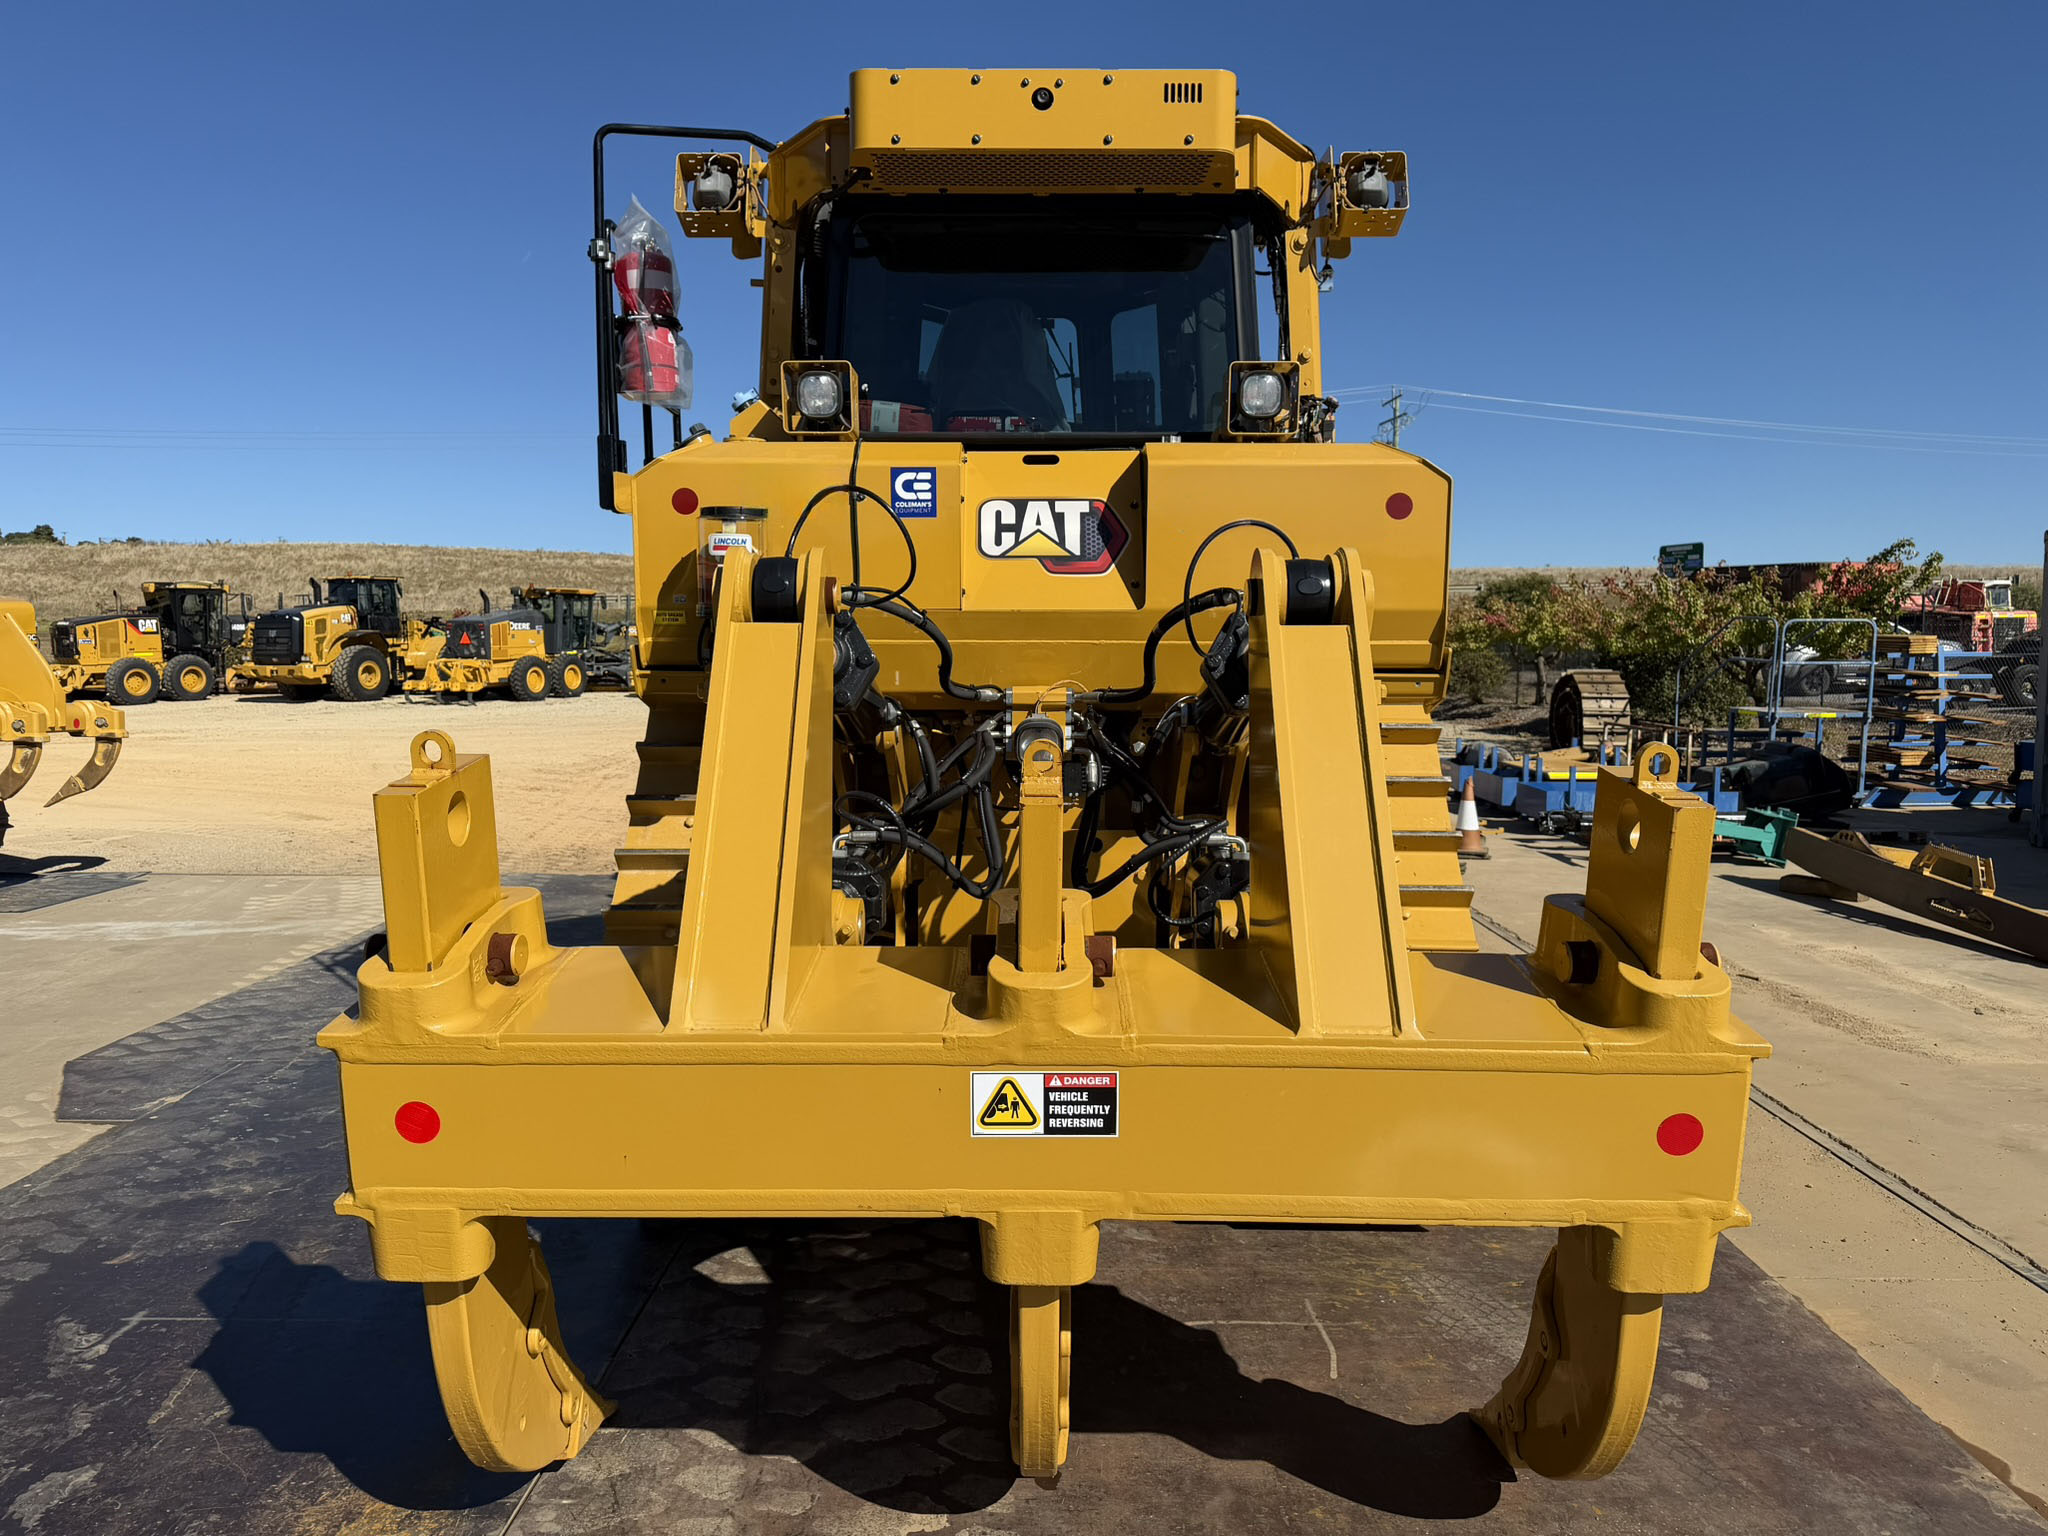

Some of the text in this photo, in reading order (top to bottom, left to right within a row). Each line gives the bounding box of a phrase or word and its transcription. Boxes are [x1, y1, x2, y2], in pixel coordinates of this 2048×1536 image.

[980, 499, 1090, 557] CAT
[713, 537, 748, 545] LINCOLN
[138, 619, 158, 633] CAT
[1063, 1076, 1110, 1085] DANGER
[1048, 1091, 1089, 1102] VEHICLE
[1048, 1105, 1111, 1115] FREQUENTLY
[1048, 1118, 1104, 1128] REVERSING
